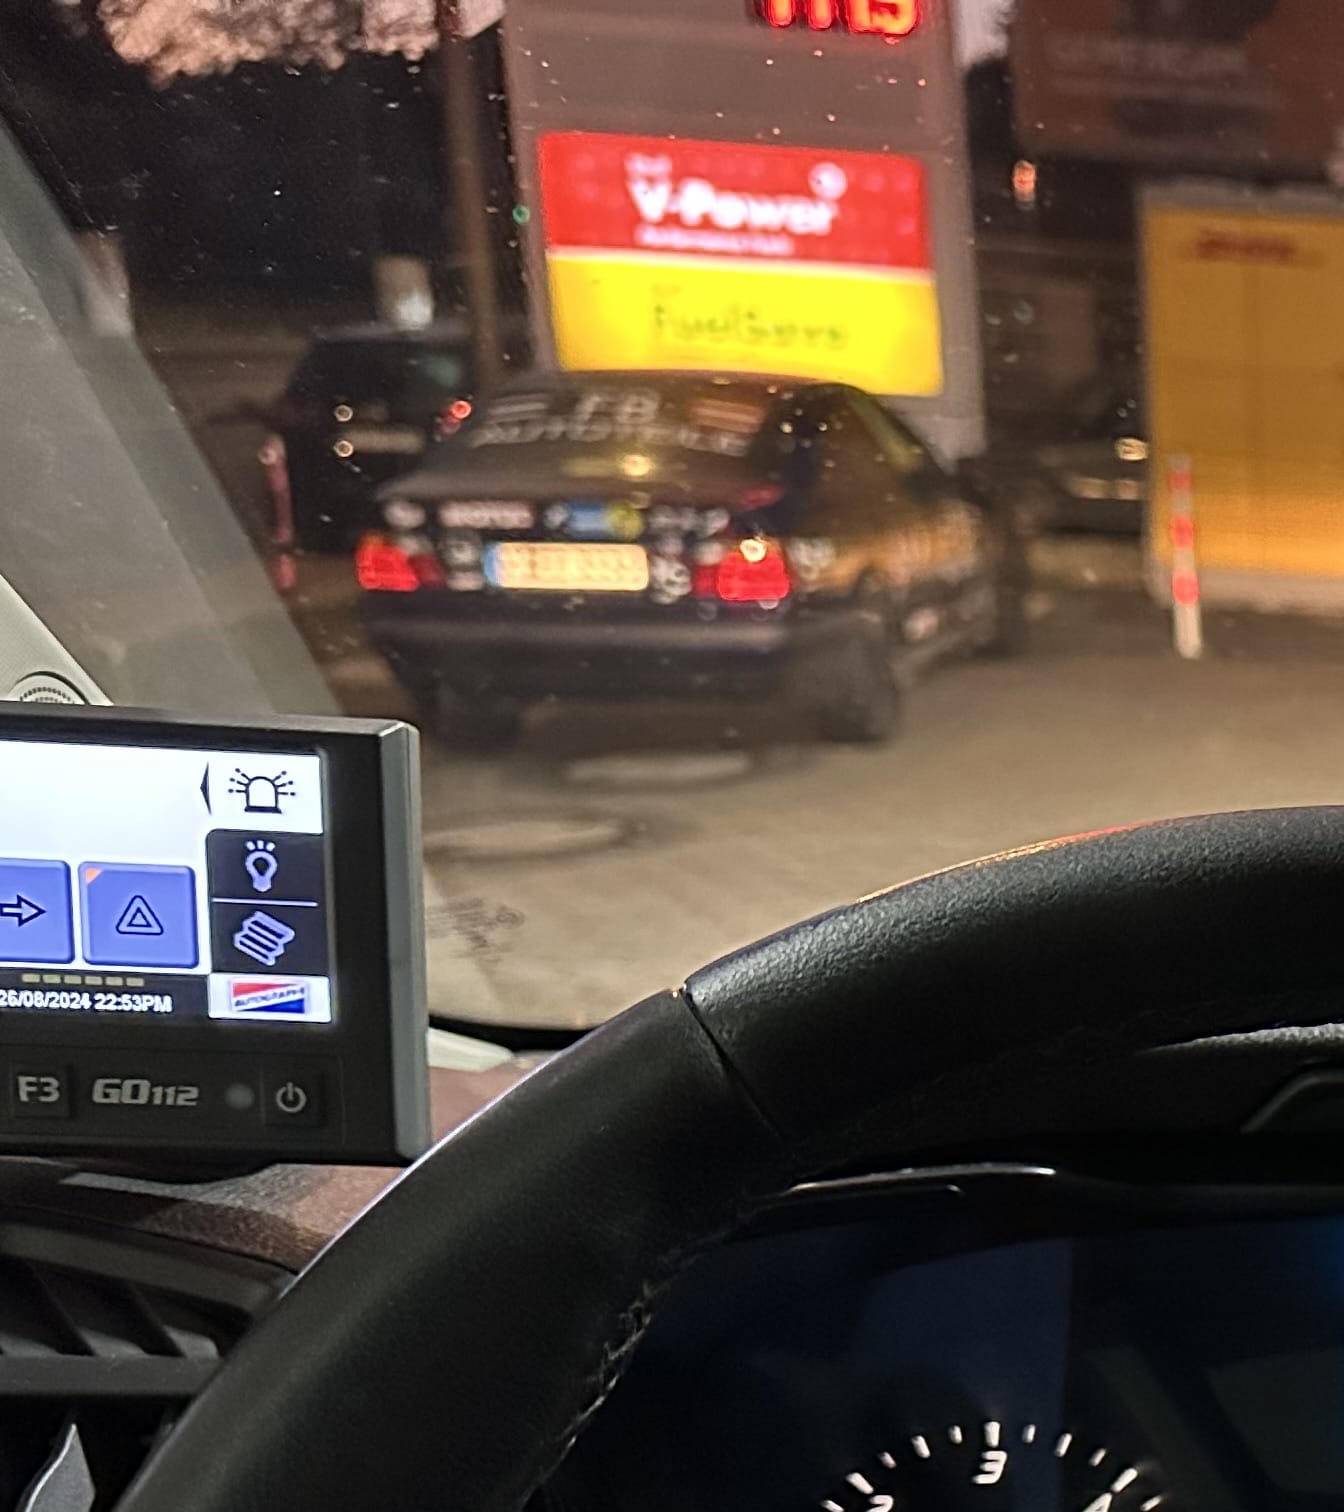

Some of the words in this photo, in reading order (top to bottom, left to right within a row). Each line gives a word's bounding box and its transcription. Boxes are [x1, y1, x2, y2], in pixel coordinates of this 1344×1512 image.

[94, 993, 173, 1013] 22:53PM
[17, 1077, 60, 1102] F3
[972, 1450, 1008, 1484] 3
